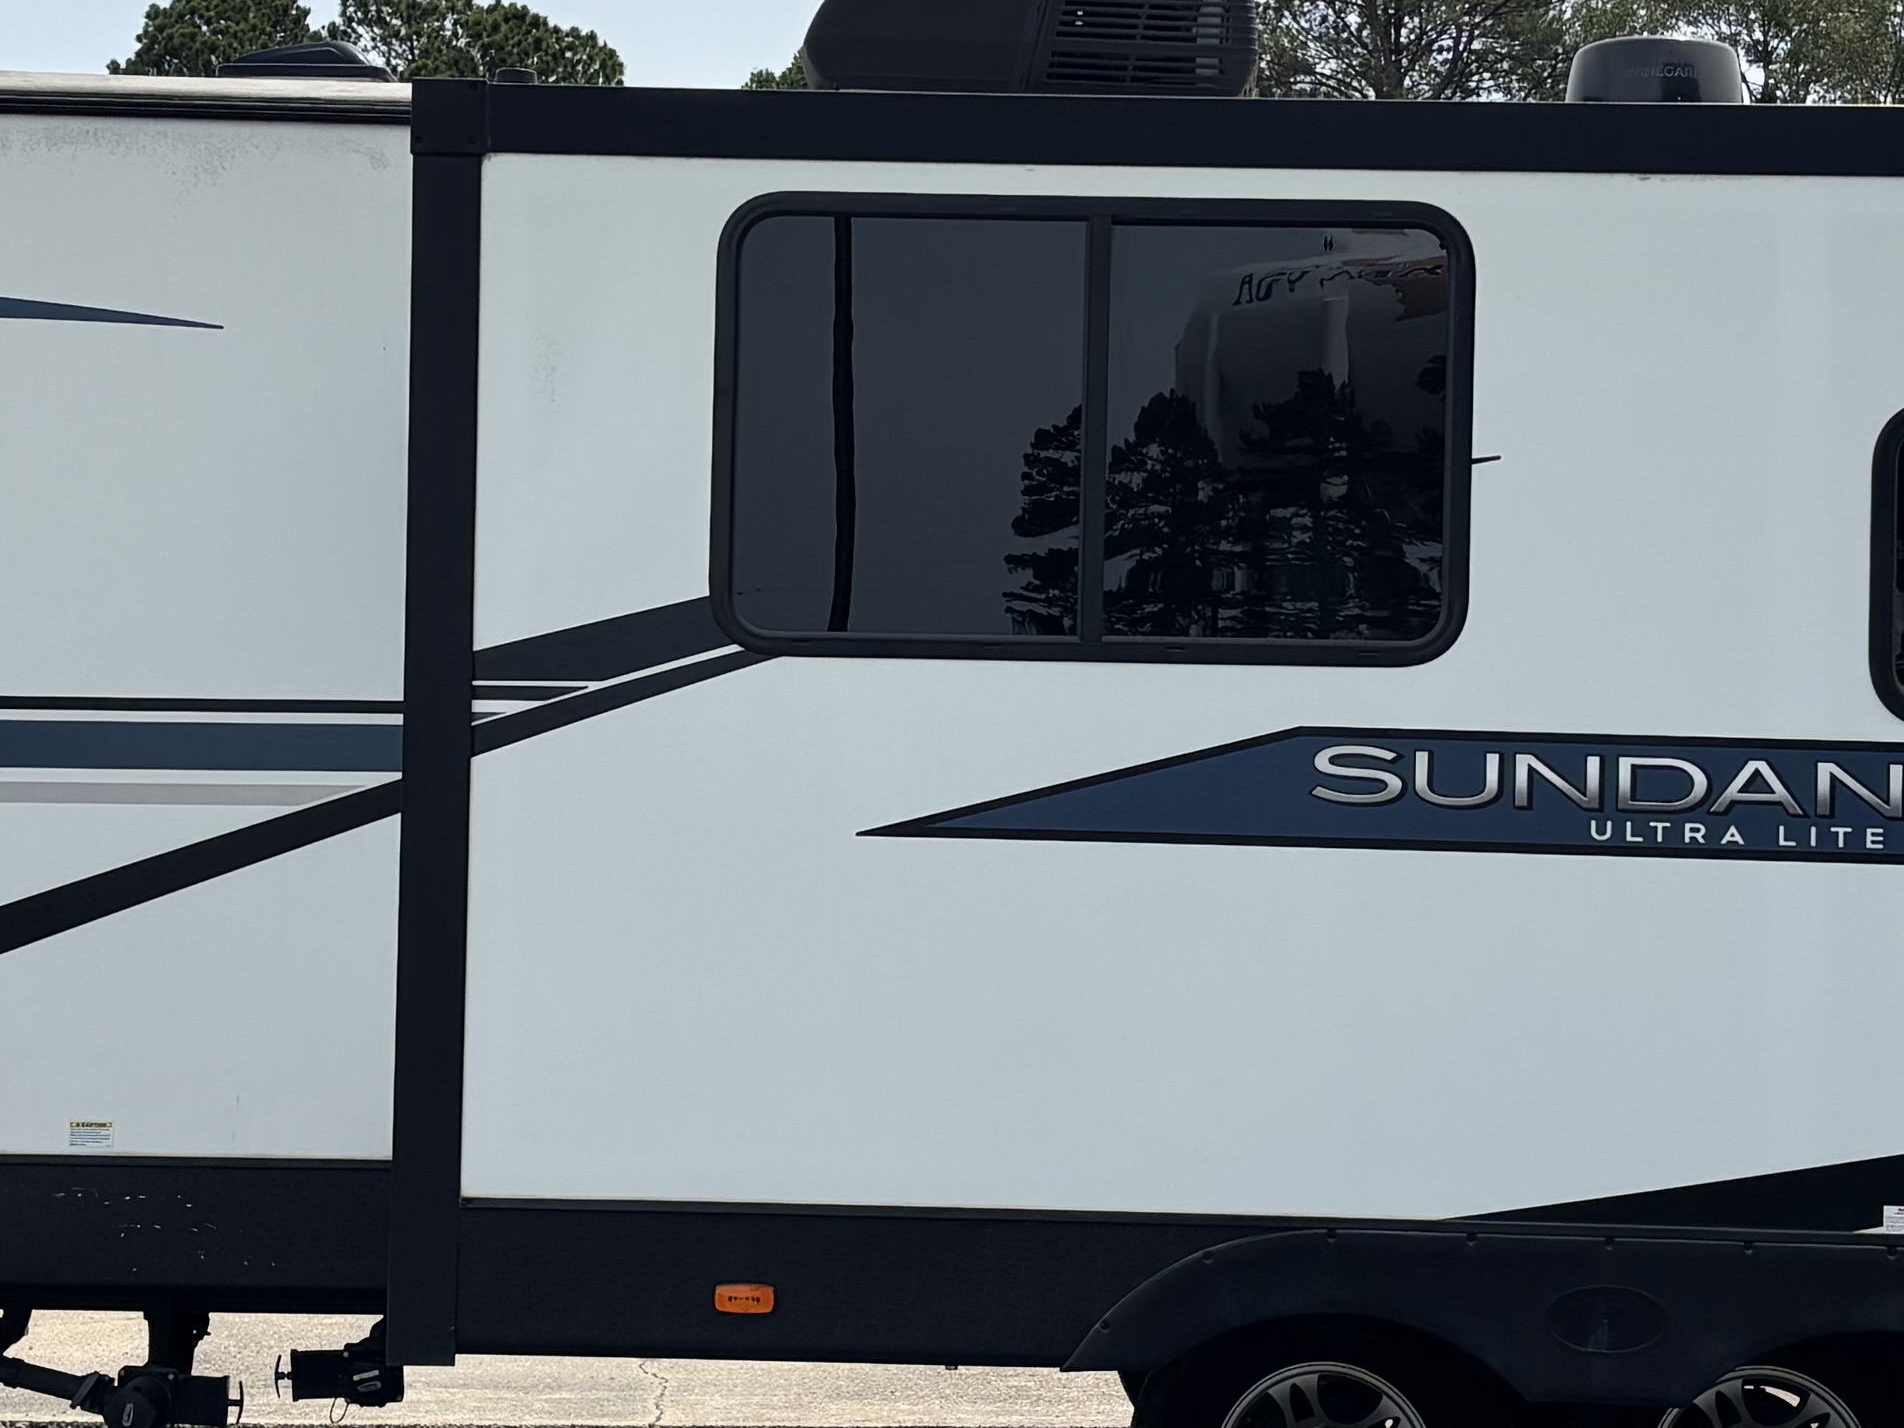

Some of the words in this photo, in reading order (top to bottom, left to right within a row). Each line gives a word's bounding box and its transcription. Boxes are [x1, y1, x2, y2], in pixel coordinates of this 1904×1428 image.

[1624, 65, 1703, 78] INEGAR
[1590, 819, 1745, 845] ULTRA
[1778, 825, 1885, 849] LITE
